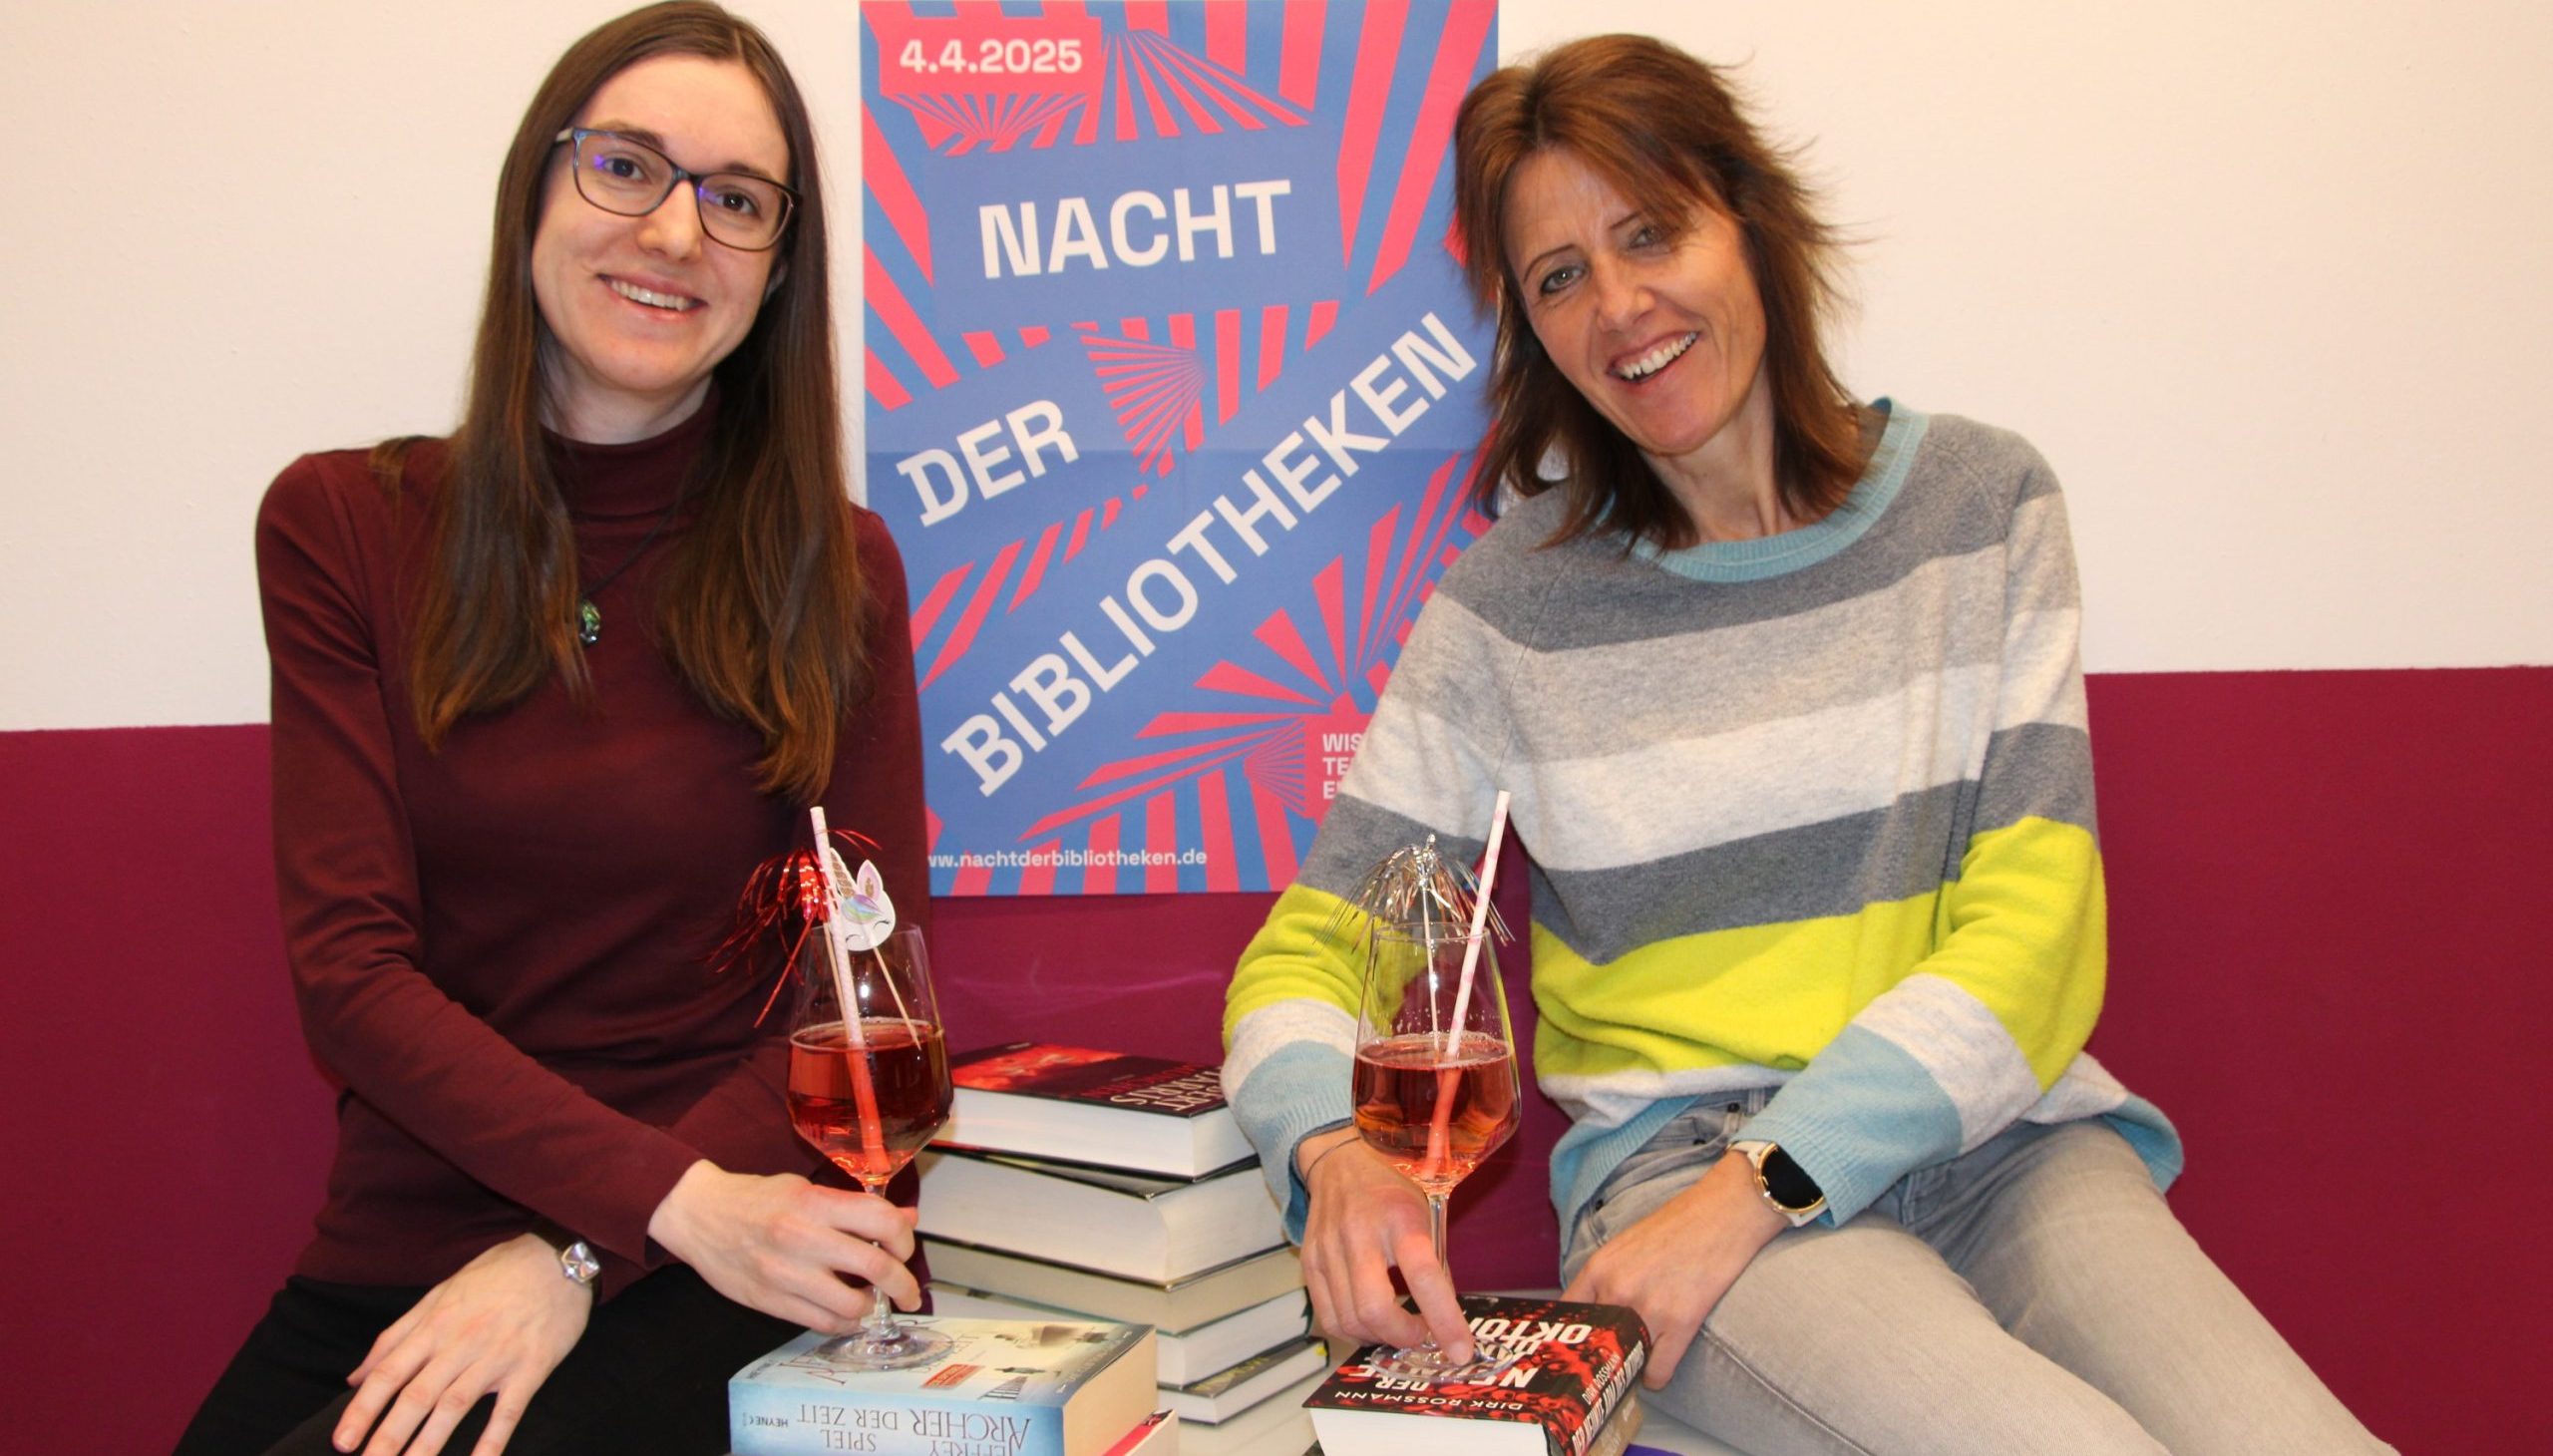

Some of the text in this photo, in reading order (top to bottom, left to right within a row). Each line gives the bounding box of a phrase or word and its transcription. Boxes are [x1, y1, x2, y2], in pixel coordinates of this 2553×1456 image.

[900, 39, 1082, 74] 4.4.2025
[978, 179, 1291, 279] NACHT
[897, 400, 1079, 527] DER
[940, 311, 1476, 796] BIBLIOTHEKEN
[798, 1403, 898, 1431] DER ZEIT
[1334, 1390, 1523, 1411] DIRK ROSSMANN
[820, 1429, 877, 1452] SPIEL
[910, 1408, 1031, 1450] ARCHER
